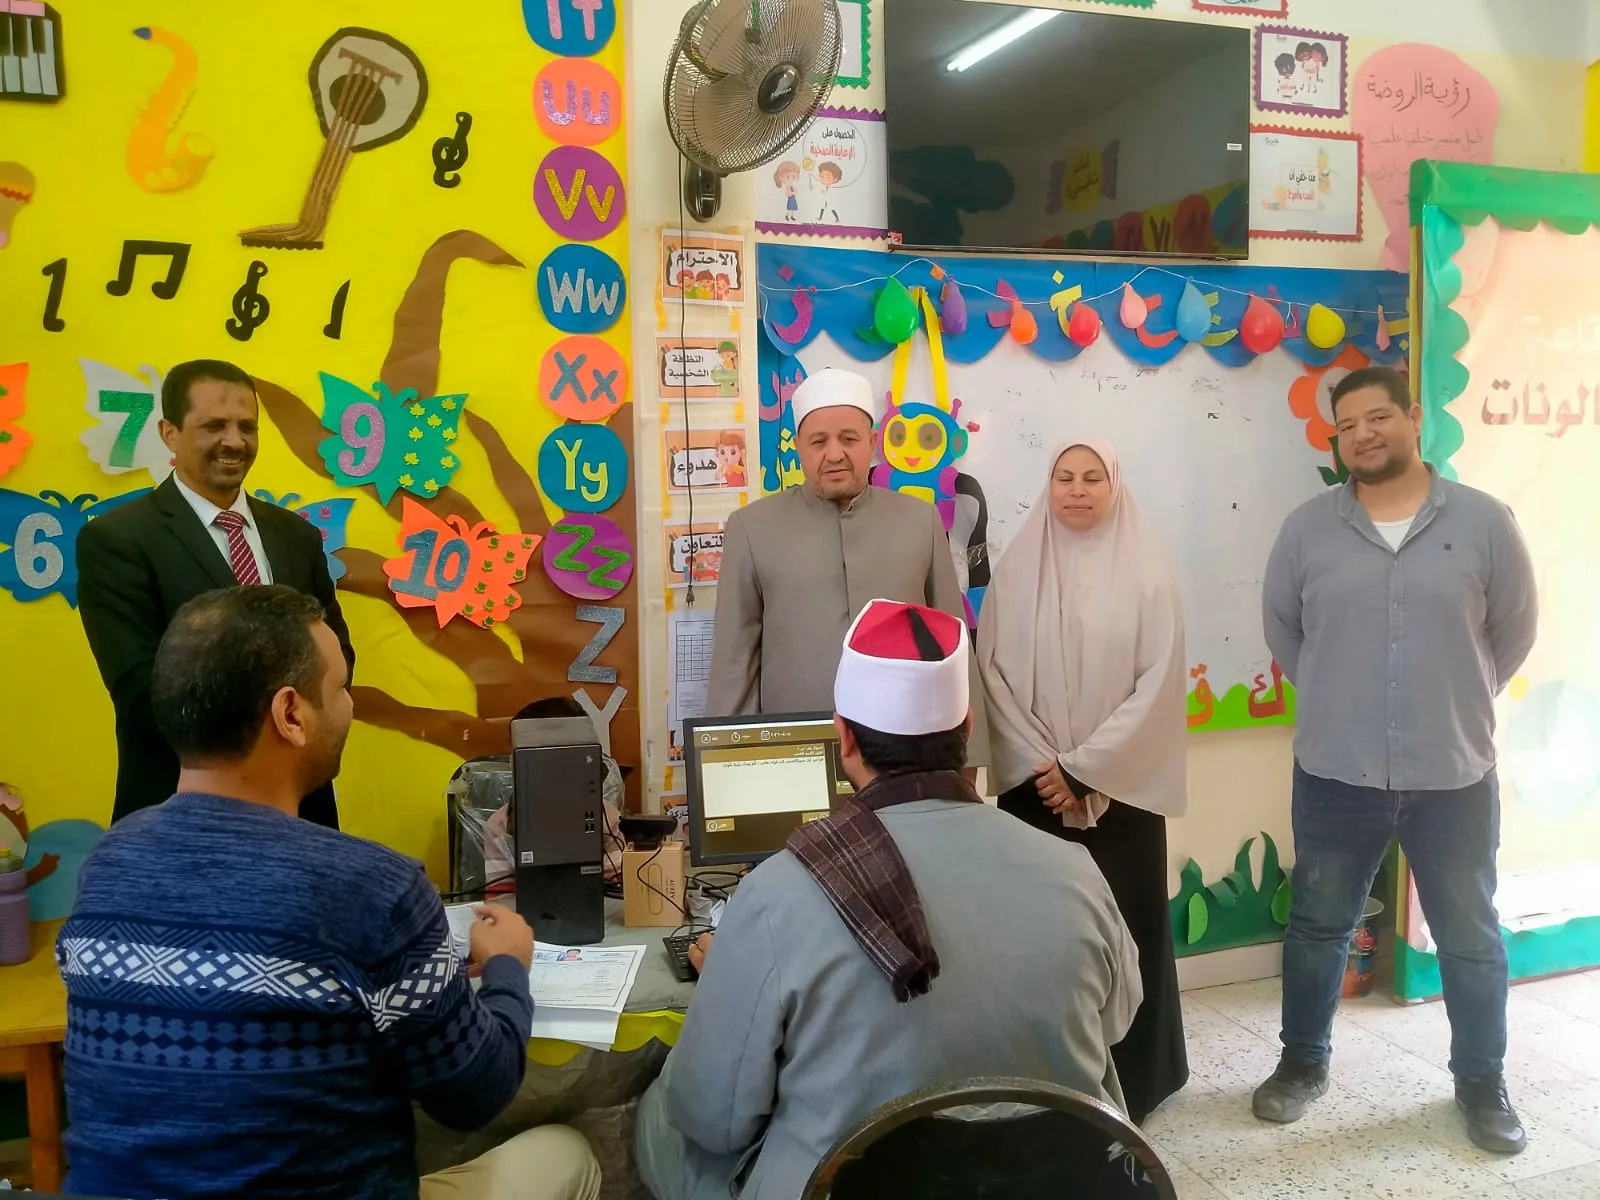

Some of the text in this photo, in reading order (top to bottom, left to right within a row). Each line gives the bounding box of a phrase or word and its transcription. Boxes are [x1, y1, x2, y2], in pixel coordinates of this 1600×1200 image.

[541, 79, 610, 126] Uu
[1367, 71, 1471, 118] رؤية الروضة
[809, 141, 834, 158] الصحية
[822, 126, 856, 140] الحصول على
[544, 168, 616, 222] Vv
[676, 251, 733, 268] الاحترام
[546, 266, 620, 316] Ww
[549, 351, 619, 404] Xx
[672, 354, 704, 363] النظفة
[98, 389, 155, 469] 7
[1480, 378, 1600, 439] الونات
[338, 402, 387, 478] 9
[677, 458, 718, 475] هدوء
[555, 438, 609, 503] Yy
[13, 511, 65, 588] 6
[391, 528, 471, 599] 10
[552, 523, 631, 591] Zz
[680, 534, 723, 554] لتعاون
[567, 604, 626, 684] Z
[571, 685, 629, 757] Y
